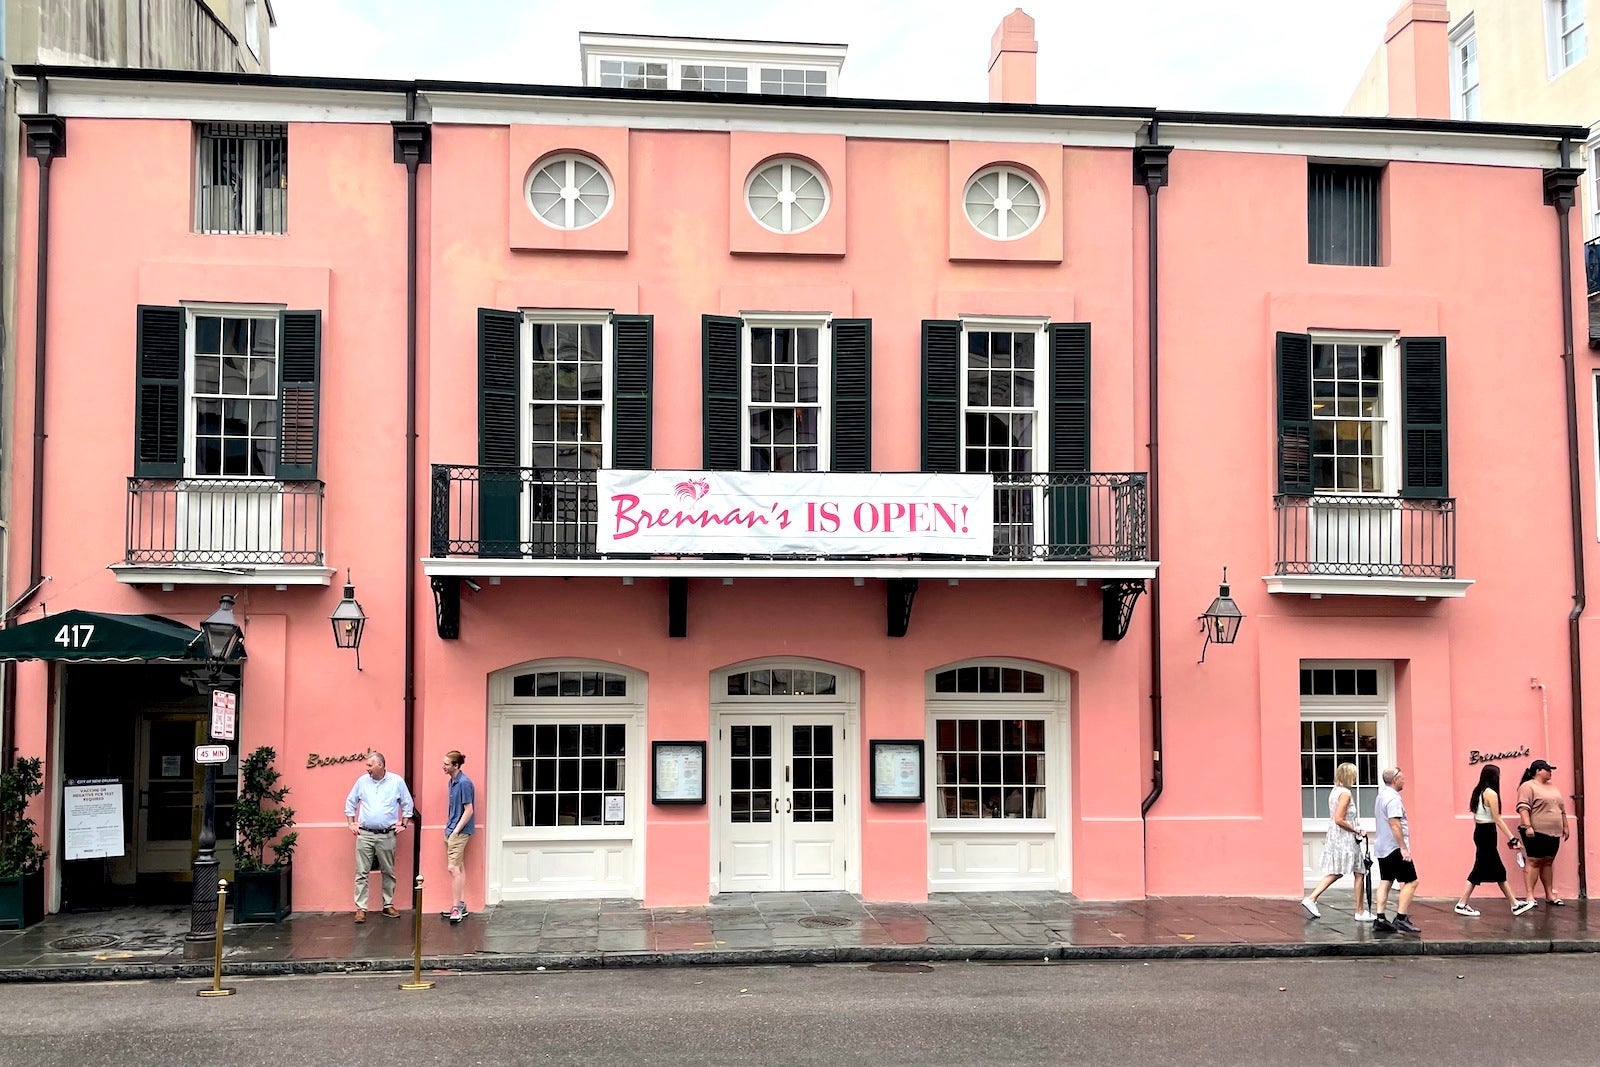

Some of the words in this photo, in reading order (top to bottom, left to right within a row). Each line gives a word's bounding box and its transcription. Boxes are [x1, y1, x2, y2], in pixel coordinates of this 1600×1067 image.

[611, 494, 791, 540] Brennan's
[805, 502, 841, 533] IS
[853, 502, 968, 533] OPEN!
[54, 624, 95, 648] 417
[200, 750, 209, 758] 45
[306, 747, 376, 769] Brennan'
